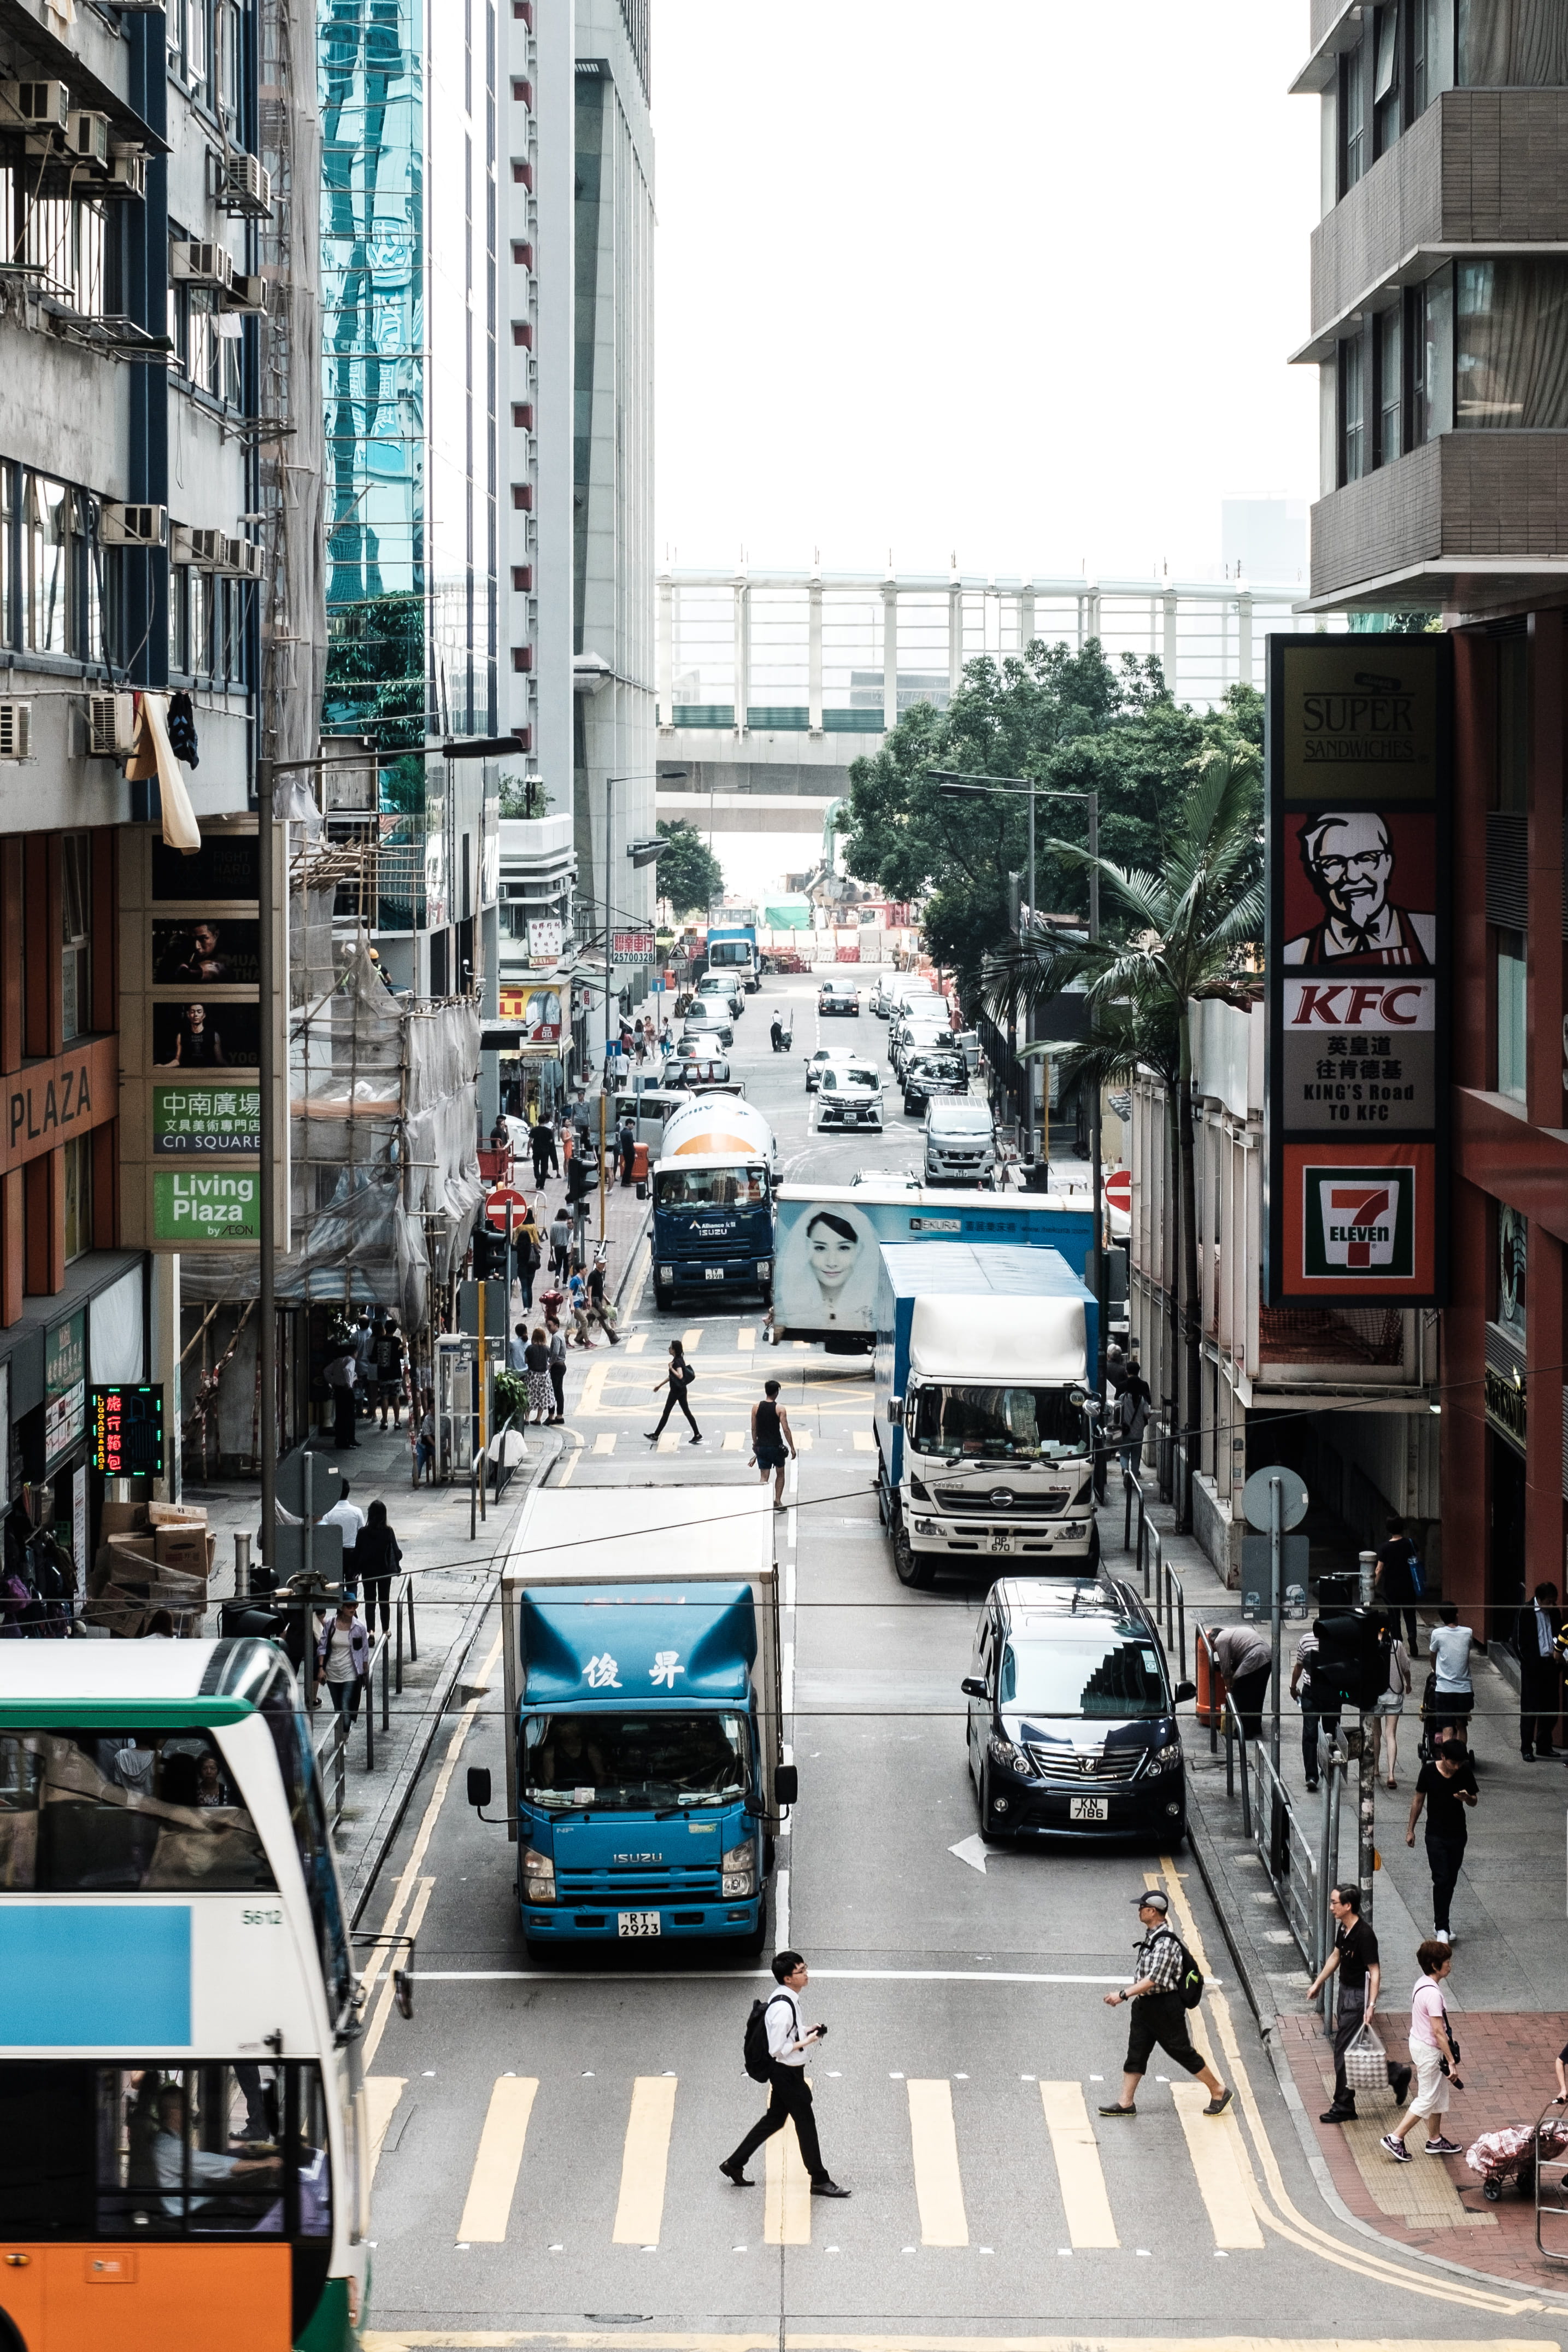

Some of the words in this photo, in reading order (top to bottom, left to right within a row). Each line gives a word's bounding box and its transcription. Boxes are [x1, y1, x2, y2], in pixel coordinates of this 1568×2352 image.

[1303, 699, 1413, 731] SUPER
[1305, 737, 1414, 758] SANDWICHES
[614, 935, 653, 953] 聯業車行
[226, 954, 260, 966] MUA
[614, 953, 653, 963] 25700328
[234, 967, 260, 980] THA
[1292, 985, 1422, 1025] KFC
[1327, 1036, 1391, 1057] 英皇道
[229, 1051, 260, 1064] YOG
[1316, 1059, 1402, 1080] 往肯德基
[1370, 1083, 1414, 1101] Road
[10, 1066, 91, 1148] PLAZA
[163, 1092, 260, 1117] 中南廣場
[1329, 1104, 1352, 1121] TO
[1356, 1104, 1389, 1121] KFC
[165, 1119, 260, 1132] 文具美術專門店
[195, 1135, 260, 1149] SQUARE
[173, 1174, 254, 1201] Living
[173, 1199, 243, 1222] Plaza
[208, 1225, 220, 1236] by
[1331, 1189, 1389, 1268] 7
[991, 1544, 1010, 1552] 670
[994, 1536, 1007, 1545] DP
[1080, 1799, 1099, 1809] KN
[1074, 1808, 1104, 1819] 7186
[613, 1852, 663, 1863] ISUZU
[241, 1909, 283, 1925] 5612
[630, 1913, 649, 1924] RT
[620, 1924, 659, 1936] 2923
